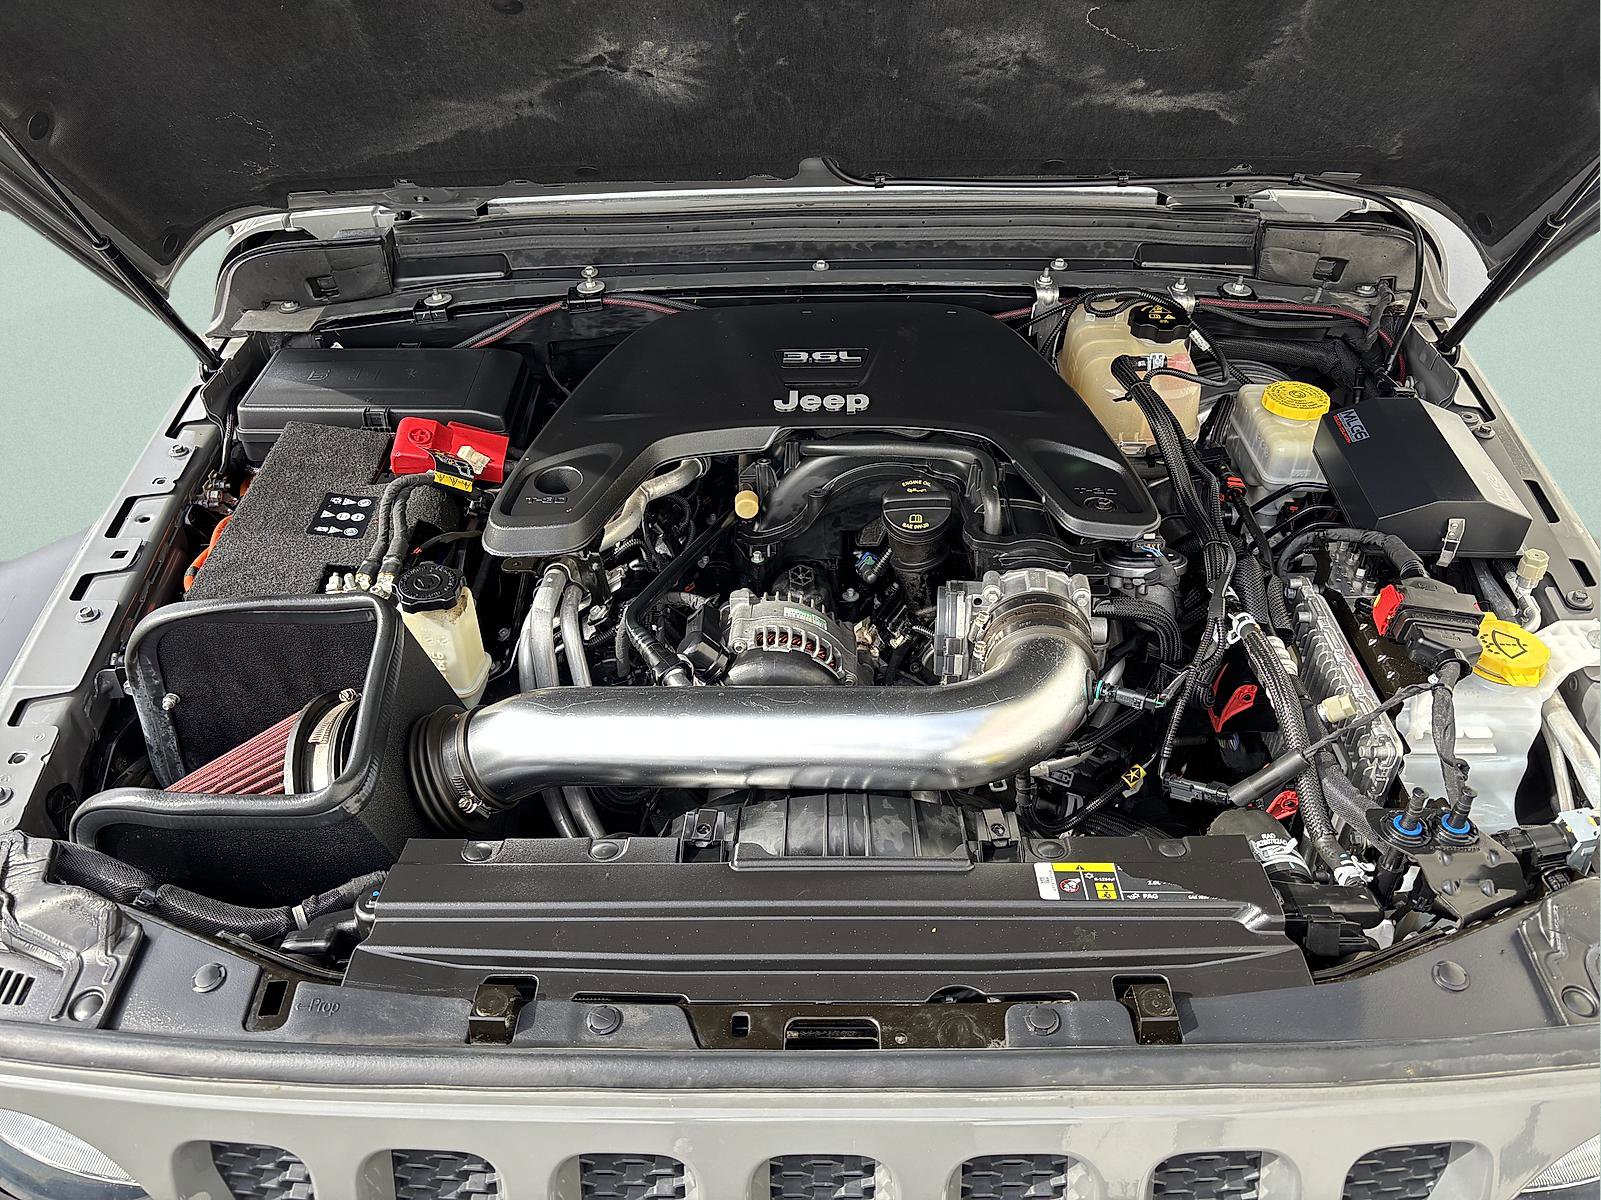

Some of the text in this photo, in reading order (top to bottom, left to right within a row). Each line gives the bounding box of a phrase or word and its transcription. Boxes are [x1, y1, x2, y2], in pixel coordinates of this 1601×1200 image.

[783, 350, 862, 364] 3.6L
[773, 390, 870, 414] Jeep
[901, 479, 922, 487] ENGINE
[308, 998, 341, 1016] Prop
